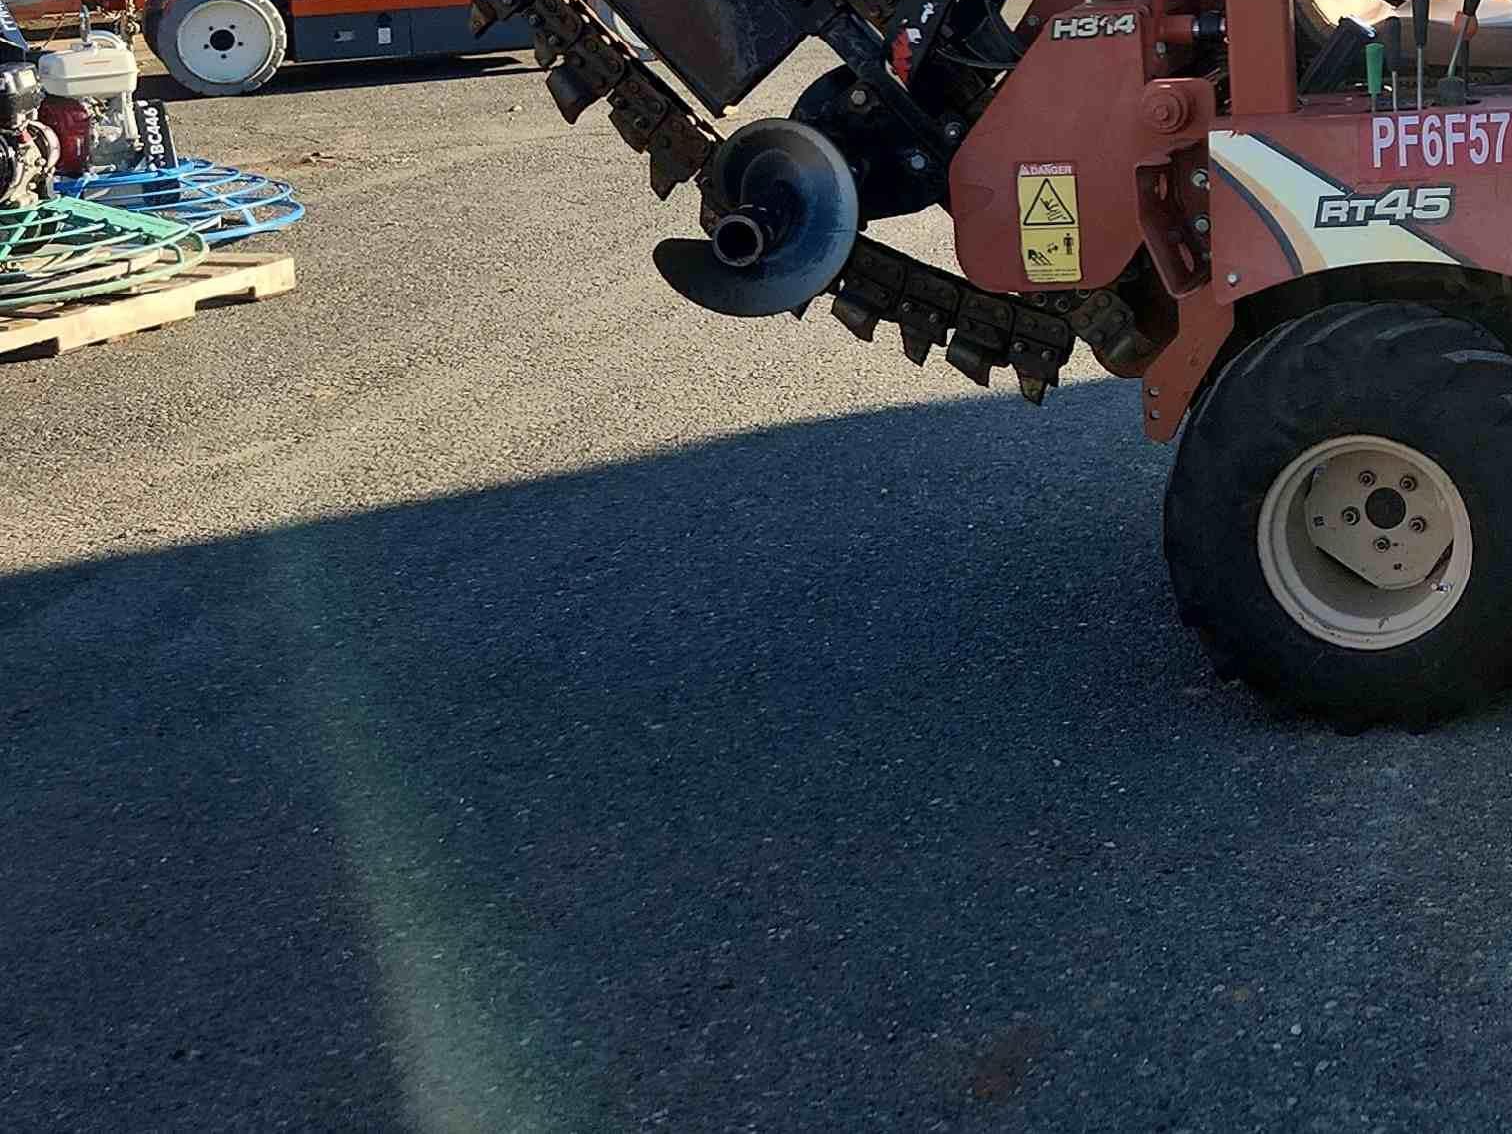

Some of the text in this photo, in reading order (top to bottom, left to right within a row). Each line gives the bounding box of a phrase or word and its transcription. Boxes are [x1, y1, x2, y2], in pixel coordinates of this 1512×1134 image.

[1054, 14, 1136, 39] H314
[143, 106, 165, 155] BC446
[1371, 113, 1511, 169] PF6F57
[1320, 187, 1452, 223] RT45
